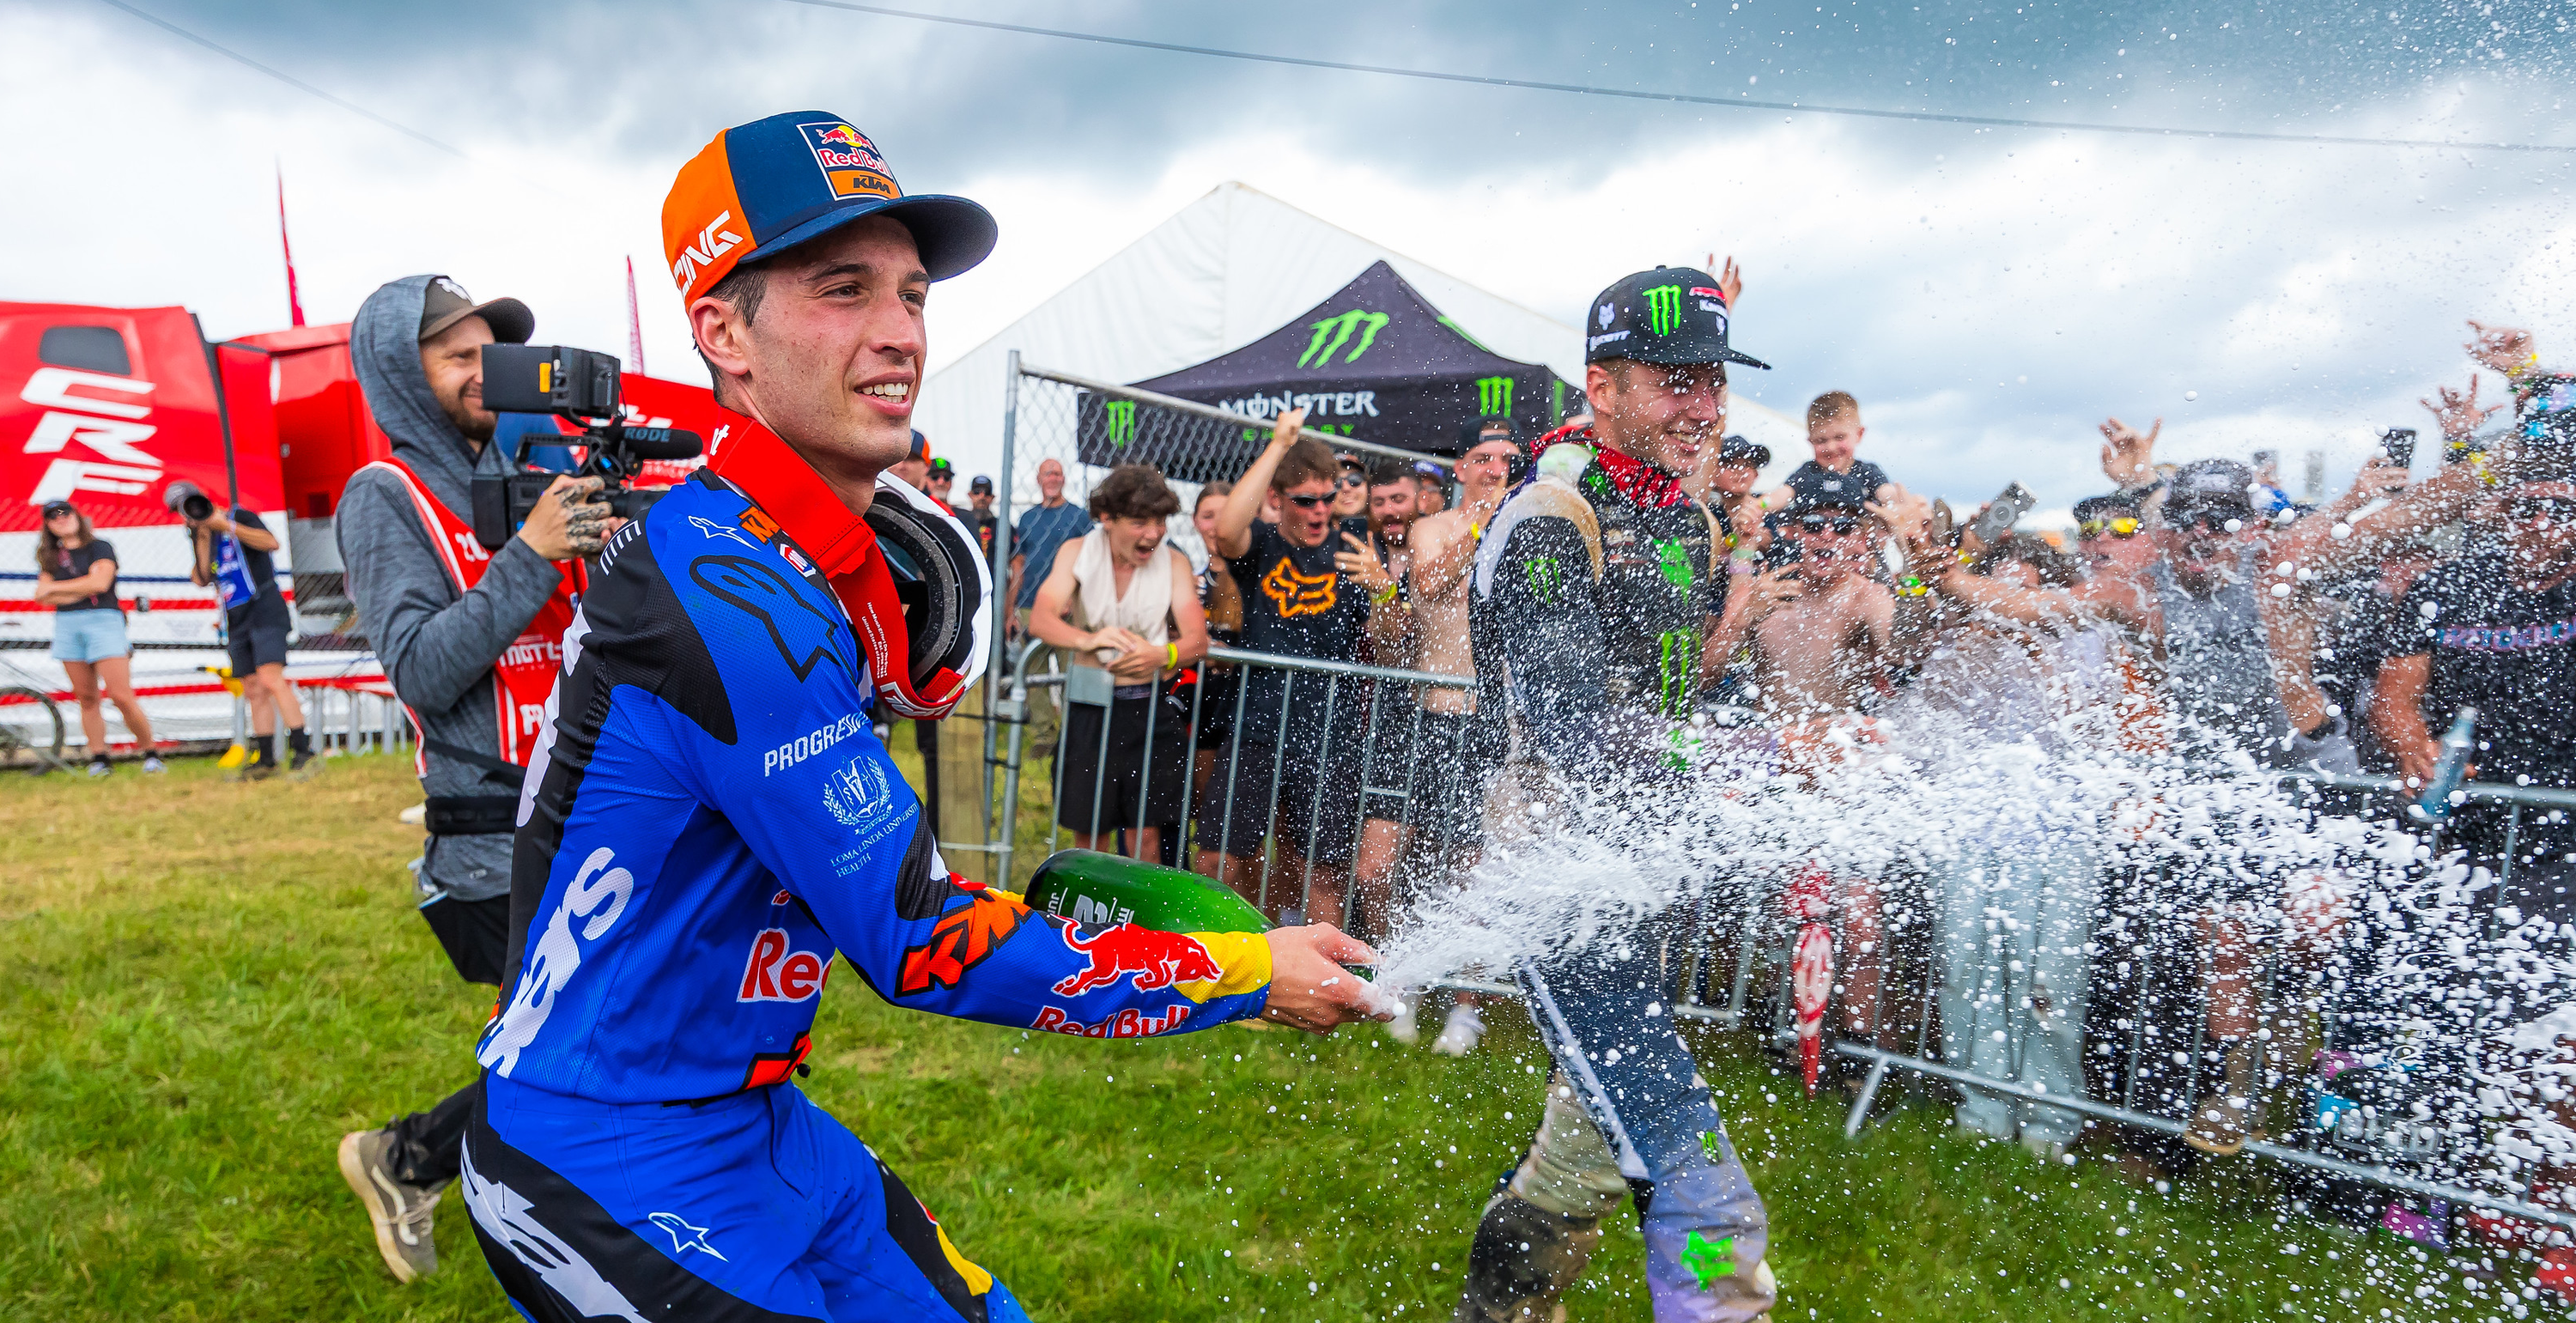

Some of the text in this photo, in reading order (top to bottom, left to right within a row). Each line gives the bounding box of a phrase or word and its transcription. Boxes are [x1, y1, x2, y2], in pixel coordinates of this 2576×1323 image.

[817, 147, 894, 179] Red Bull
[853, 174, 891, 194] KTM
[1218, 390, 1380, 421] MONSTER
[20, 367, 164, 507] CRF
[1242, 423, 1355, 441] ENGY
[830, 849, 859, 867] LOMA
[858, 830, 884, 853] LINDA
[835, 853, 872, 877] HEALTH
[737, 927, 835, 1003] Re
[1030, 1004, 1190, 1039] Red Bull
